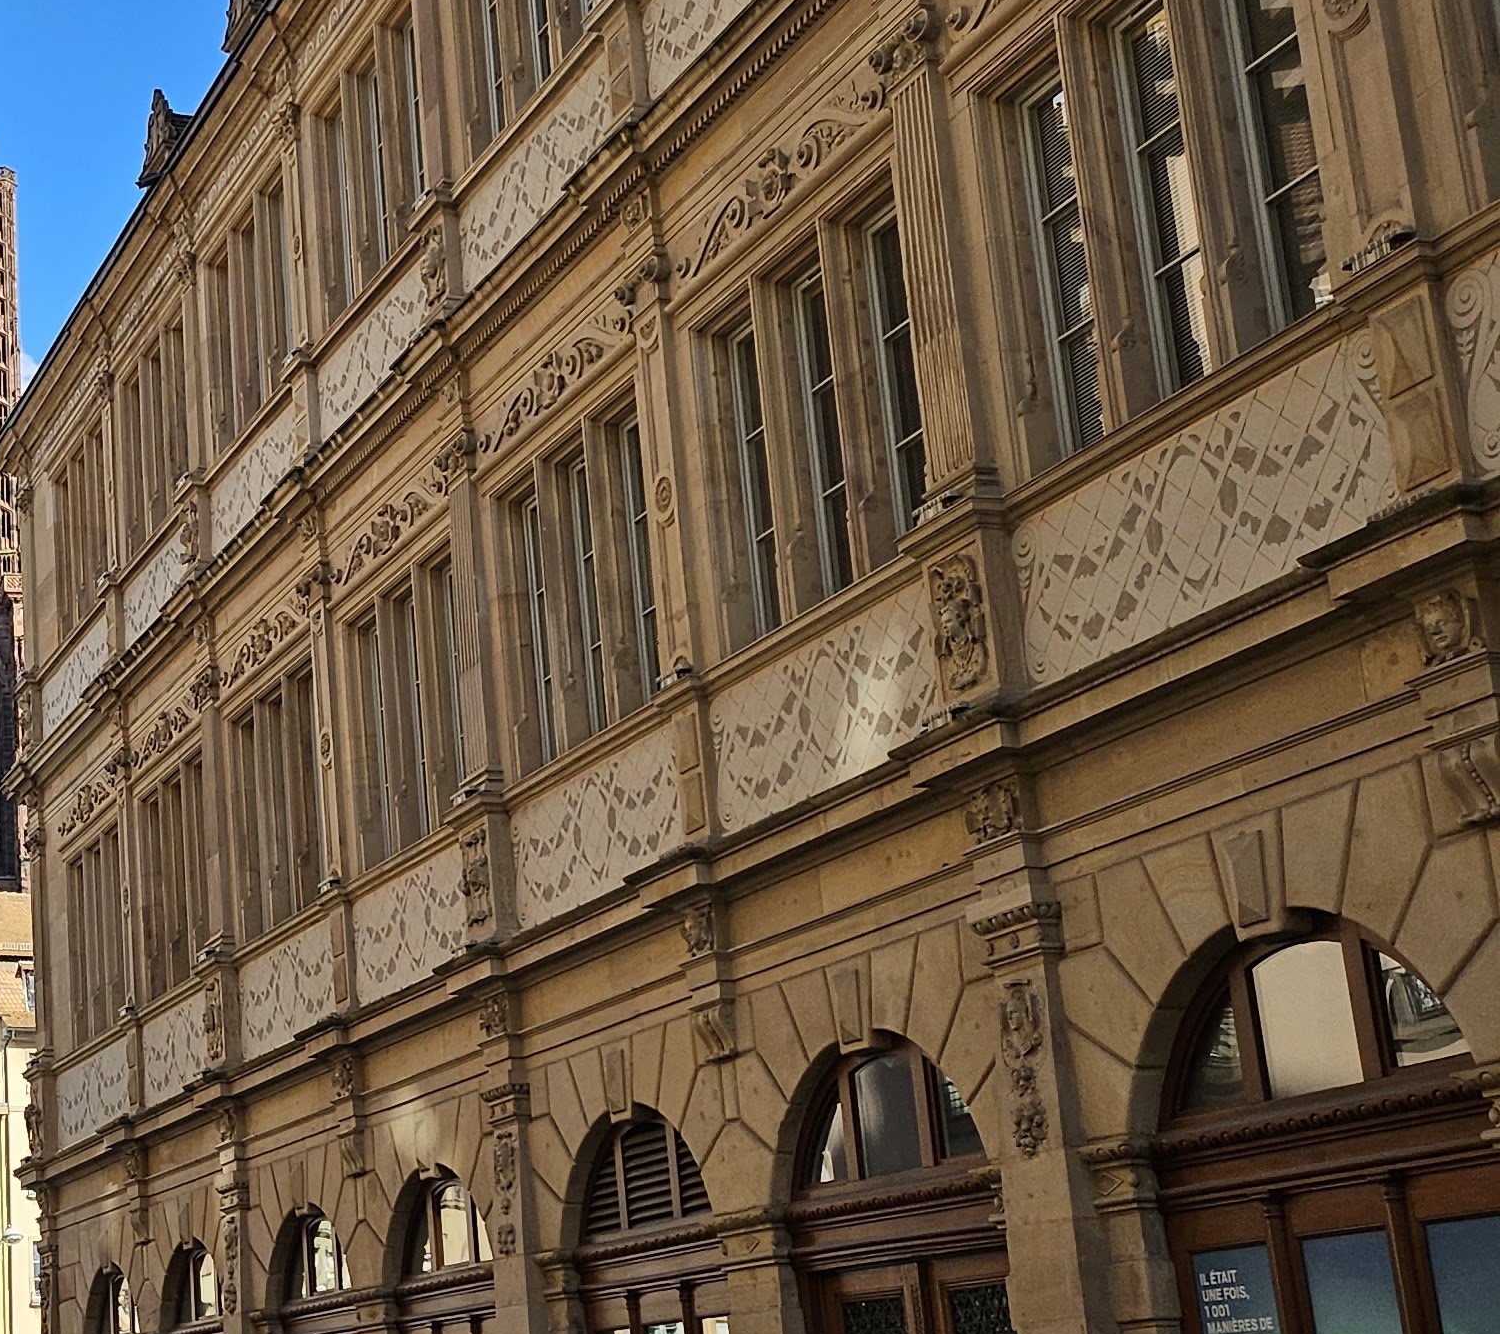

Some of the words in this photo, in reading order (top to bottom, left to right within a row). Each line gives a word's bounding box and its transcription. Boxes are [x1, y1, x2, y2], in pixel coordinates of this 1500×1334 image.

[1199, 1273, 1210, 1286] IL
[1209, 1269, 1237, 1285] ÉTAIT
[1202, 1288, 1224, 1302] UNE
[1223, 1285, 1250, 1301] FOIS,
[1258, 1316, 1274, 1331] DE
